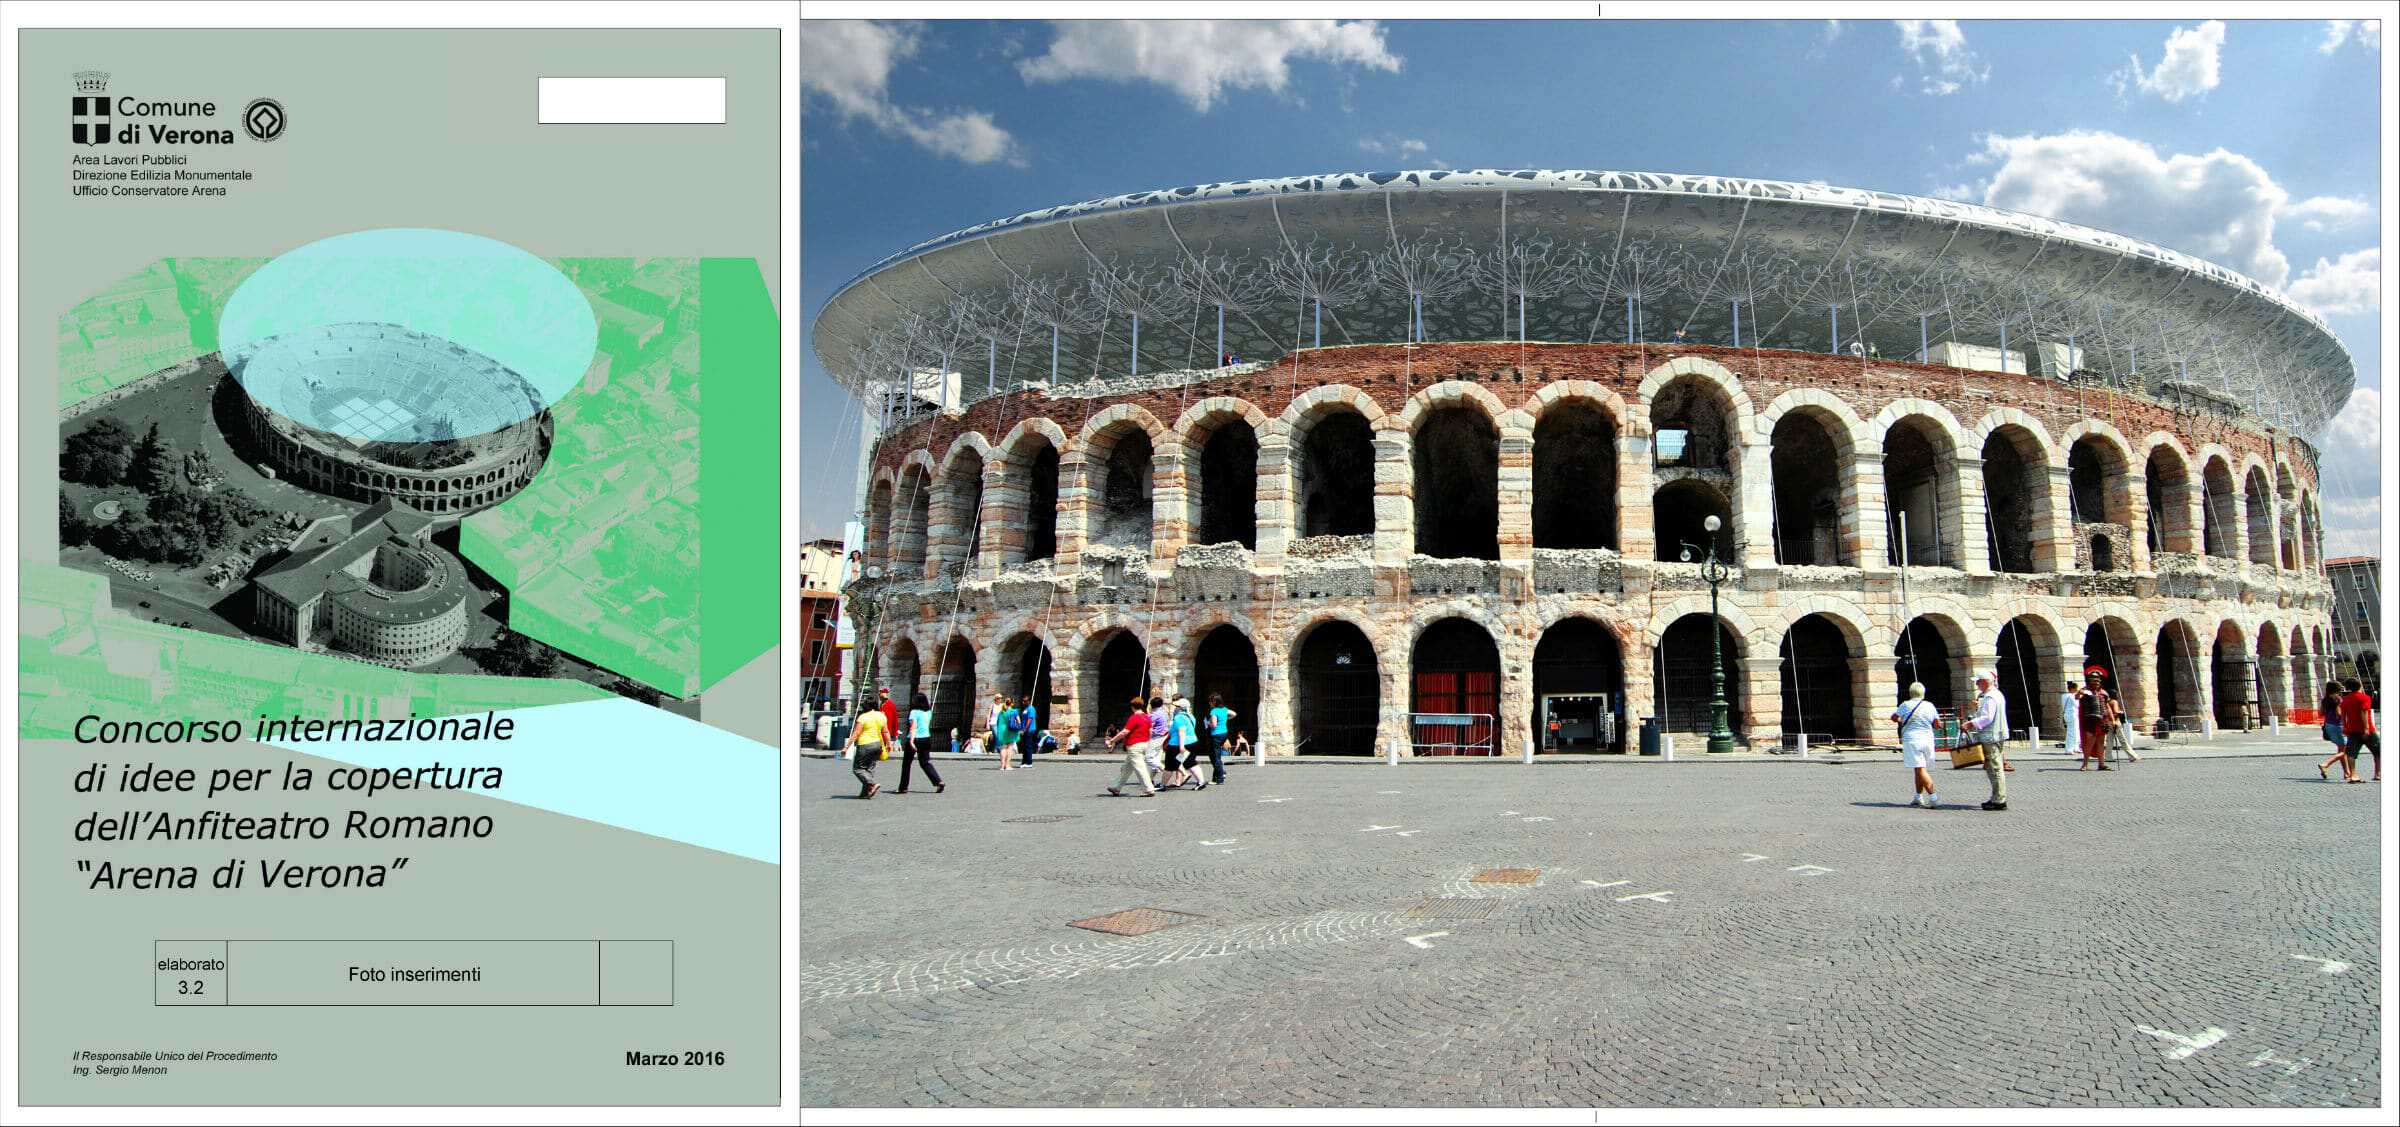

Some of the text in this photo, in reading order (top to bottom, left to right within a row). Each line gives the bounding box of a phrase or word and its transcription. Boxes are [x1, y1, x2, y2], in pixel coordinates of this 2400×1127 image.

[118, 96, 216, 117] Comune
[118, 123, 234, 145] di Verona
[72, 154, 187, 166] Area Lavori Pubblici
[73, 169, 252, 181] Direzione Edilizia Monumentale
[73, 185, 227, 197] Ufficio Conservatore Arena
[73, 710, 515, 744] Concorso internazionale
[74, 760, 503, 799] di idee per la copertura
[344, 810, 494, 840] Romano
[212, 858, 246, 890] di
[157, 957, 225, 971] elaborato
[349, 966, 481, 983] Foto inserimenti
[178, 979, 204, 996] 3.2
[72, 1050, 278, 1063] Il Responsabile Unico del Procedimento
[626, 1051, 725, 1066] Marzo 2016
[73, 1064, 168, 1077] Ing. Sergio Menon
